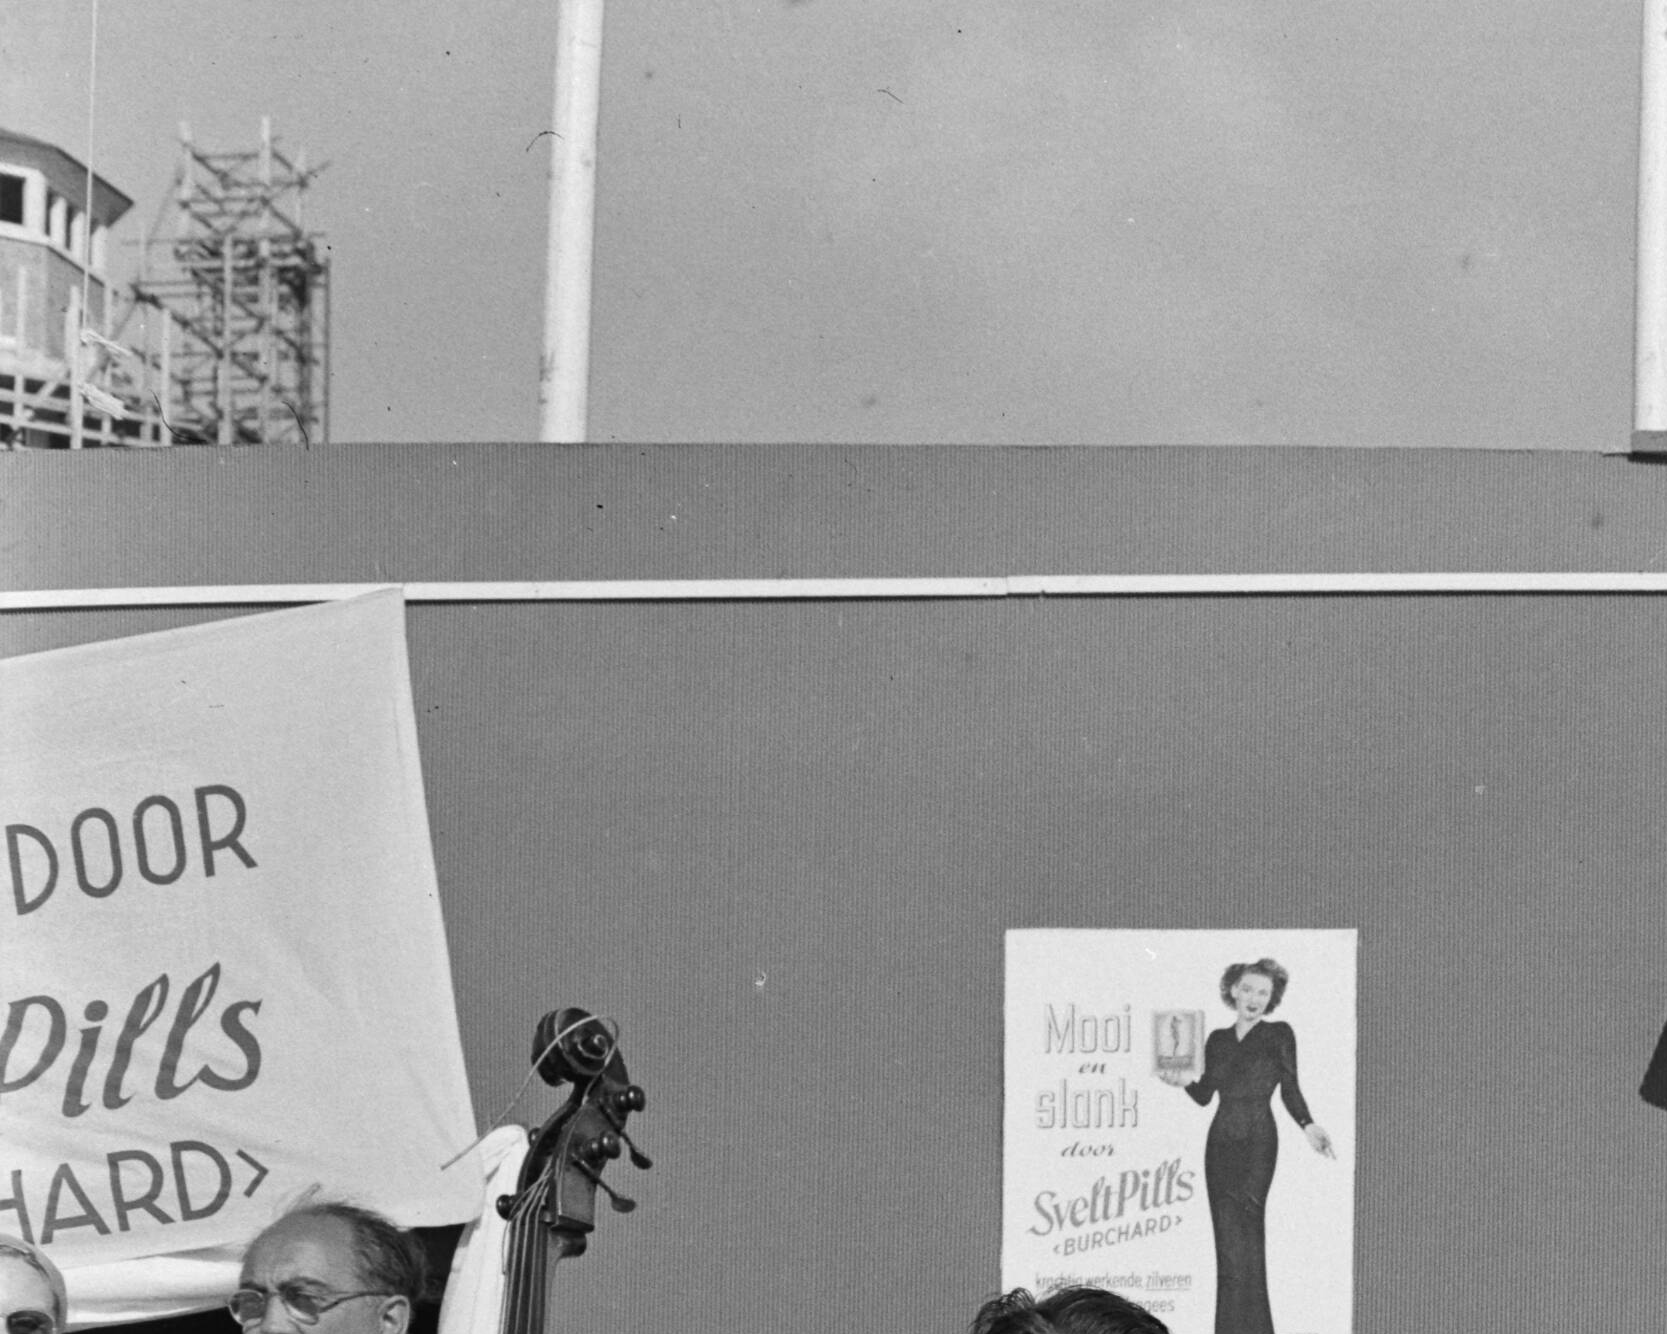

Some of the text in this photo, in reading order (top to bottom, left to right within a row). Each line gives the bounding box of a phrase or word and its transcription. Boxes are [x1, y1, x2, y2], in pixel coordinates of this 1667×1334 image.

[5, 785, 258, 916] DOOR
[1045, 1003, 1132, 1054] Mooi
[1078, 1062, 1107, 1075] en
[1036, 1077, 1139, 1129] slank
[1060, 1141, 1115, 1157] door
